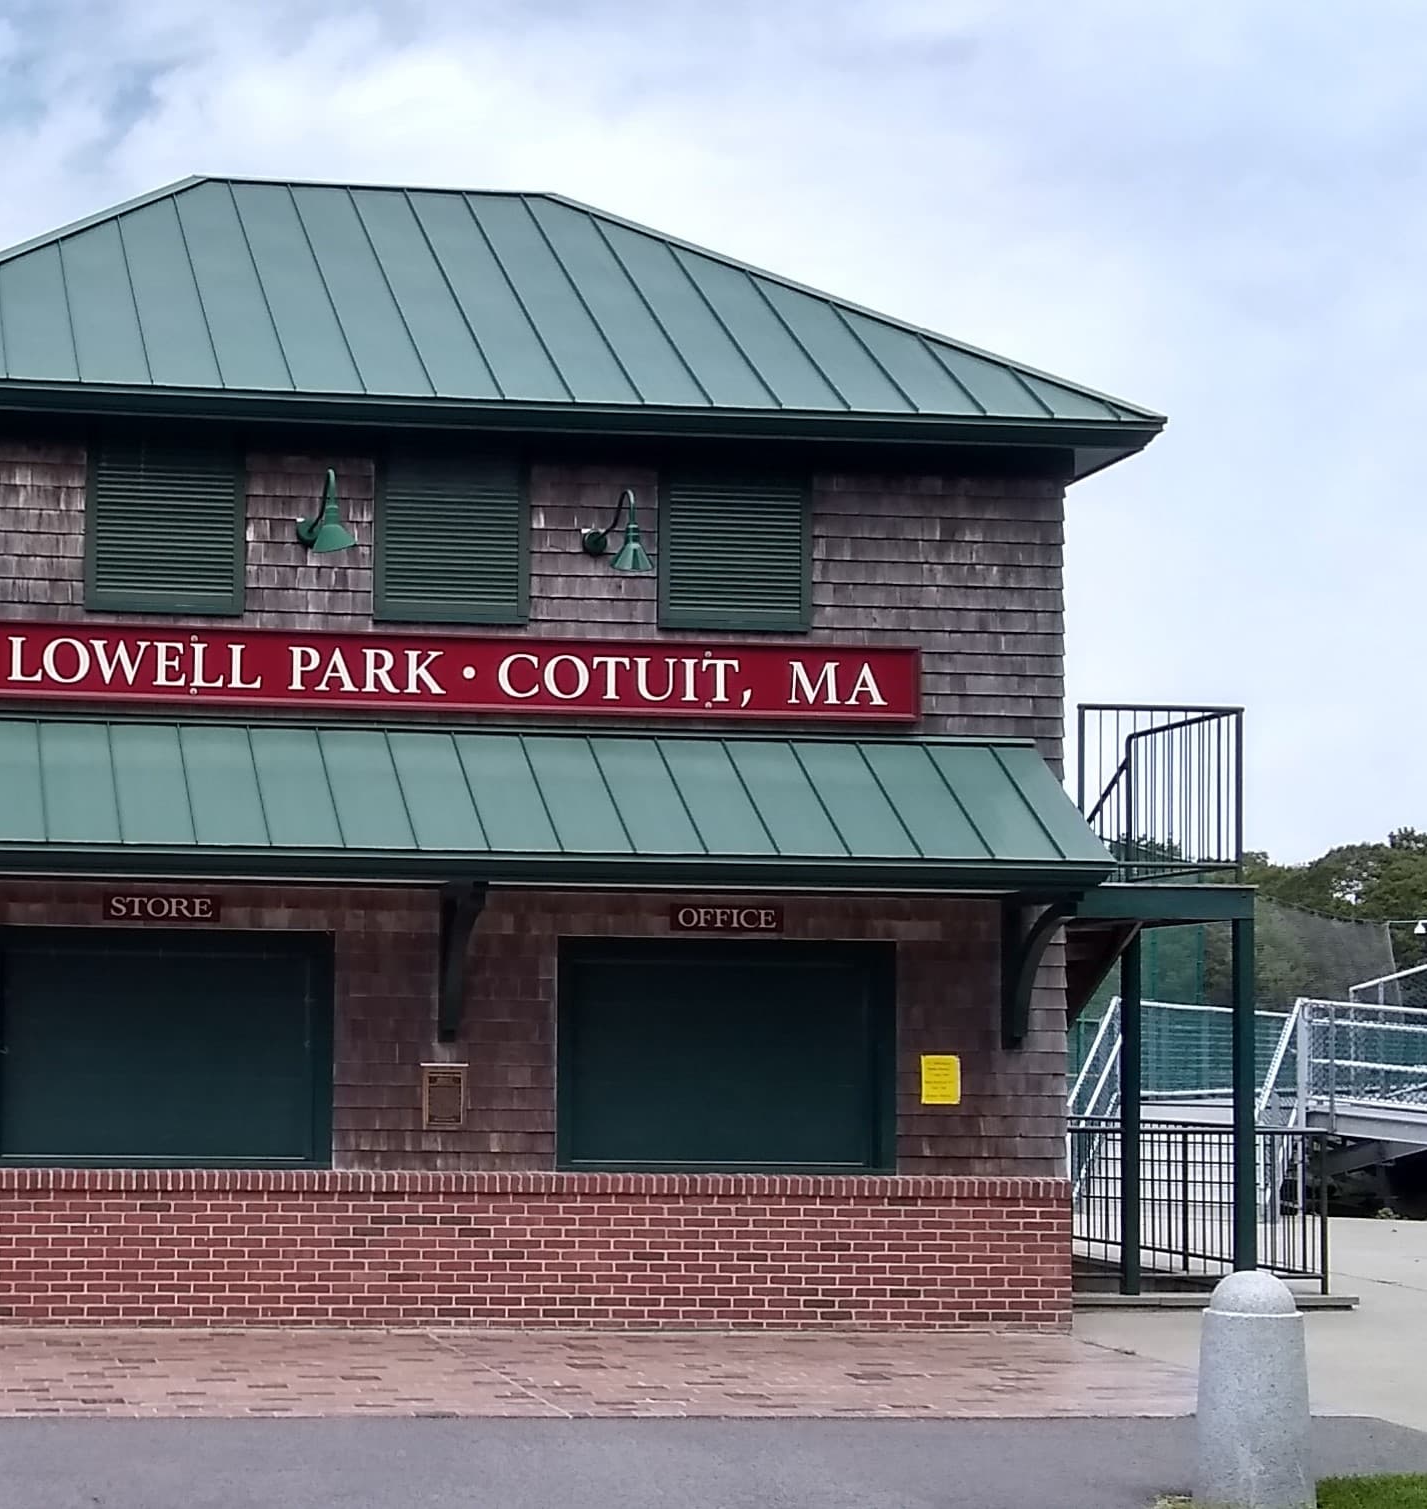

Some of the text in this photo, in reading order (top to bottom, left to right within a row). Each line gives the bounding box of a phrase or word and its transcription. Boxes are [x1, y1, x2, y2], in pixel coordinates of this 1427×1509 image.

[7, 636, 261, 689] LOWELL
[287, 646, 447, 695] PARK
[498, 653, 752, 708] COTUIT,
[786, 661, 888, 706] MA
[110, 896, 213, 918] STORE
[678, 907, 777, 928] OFFICE
